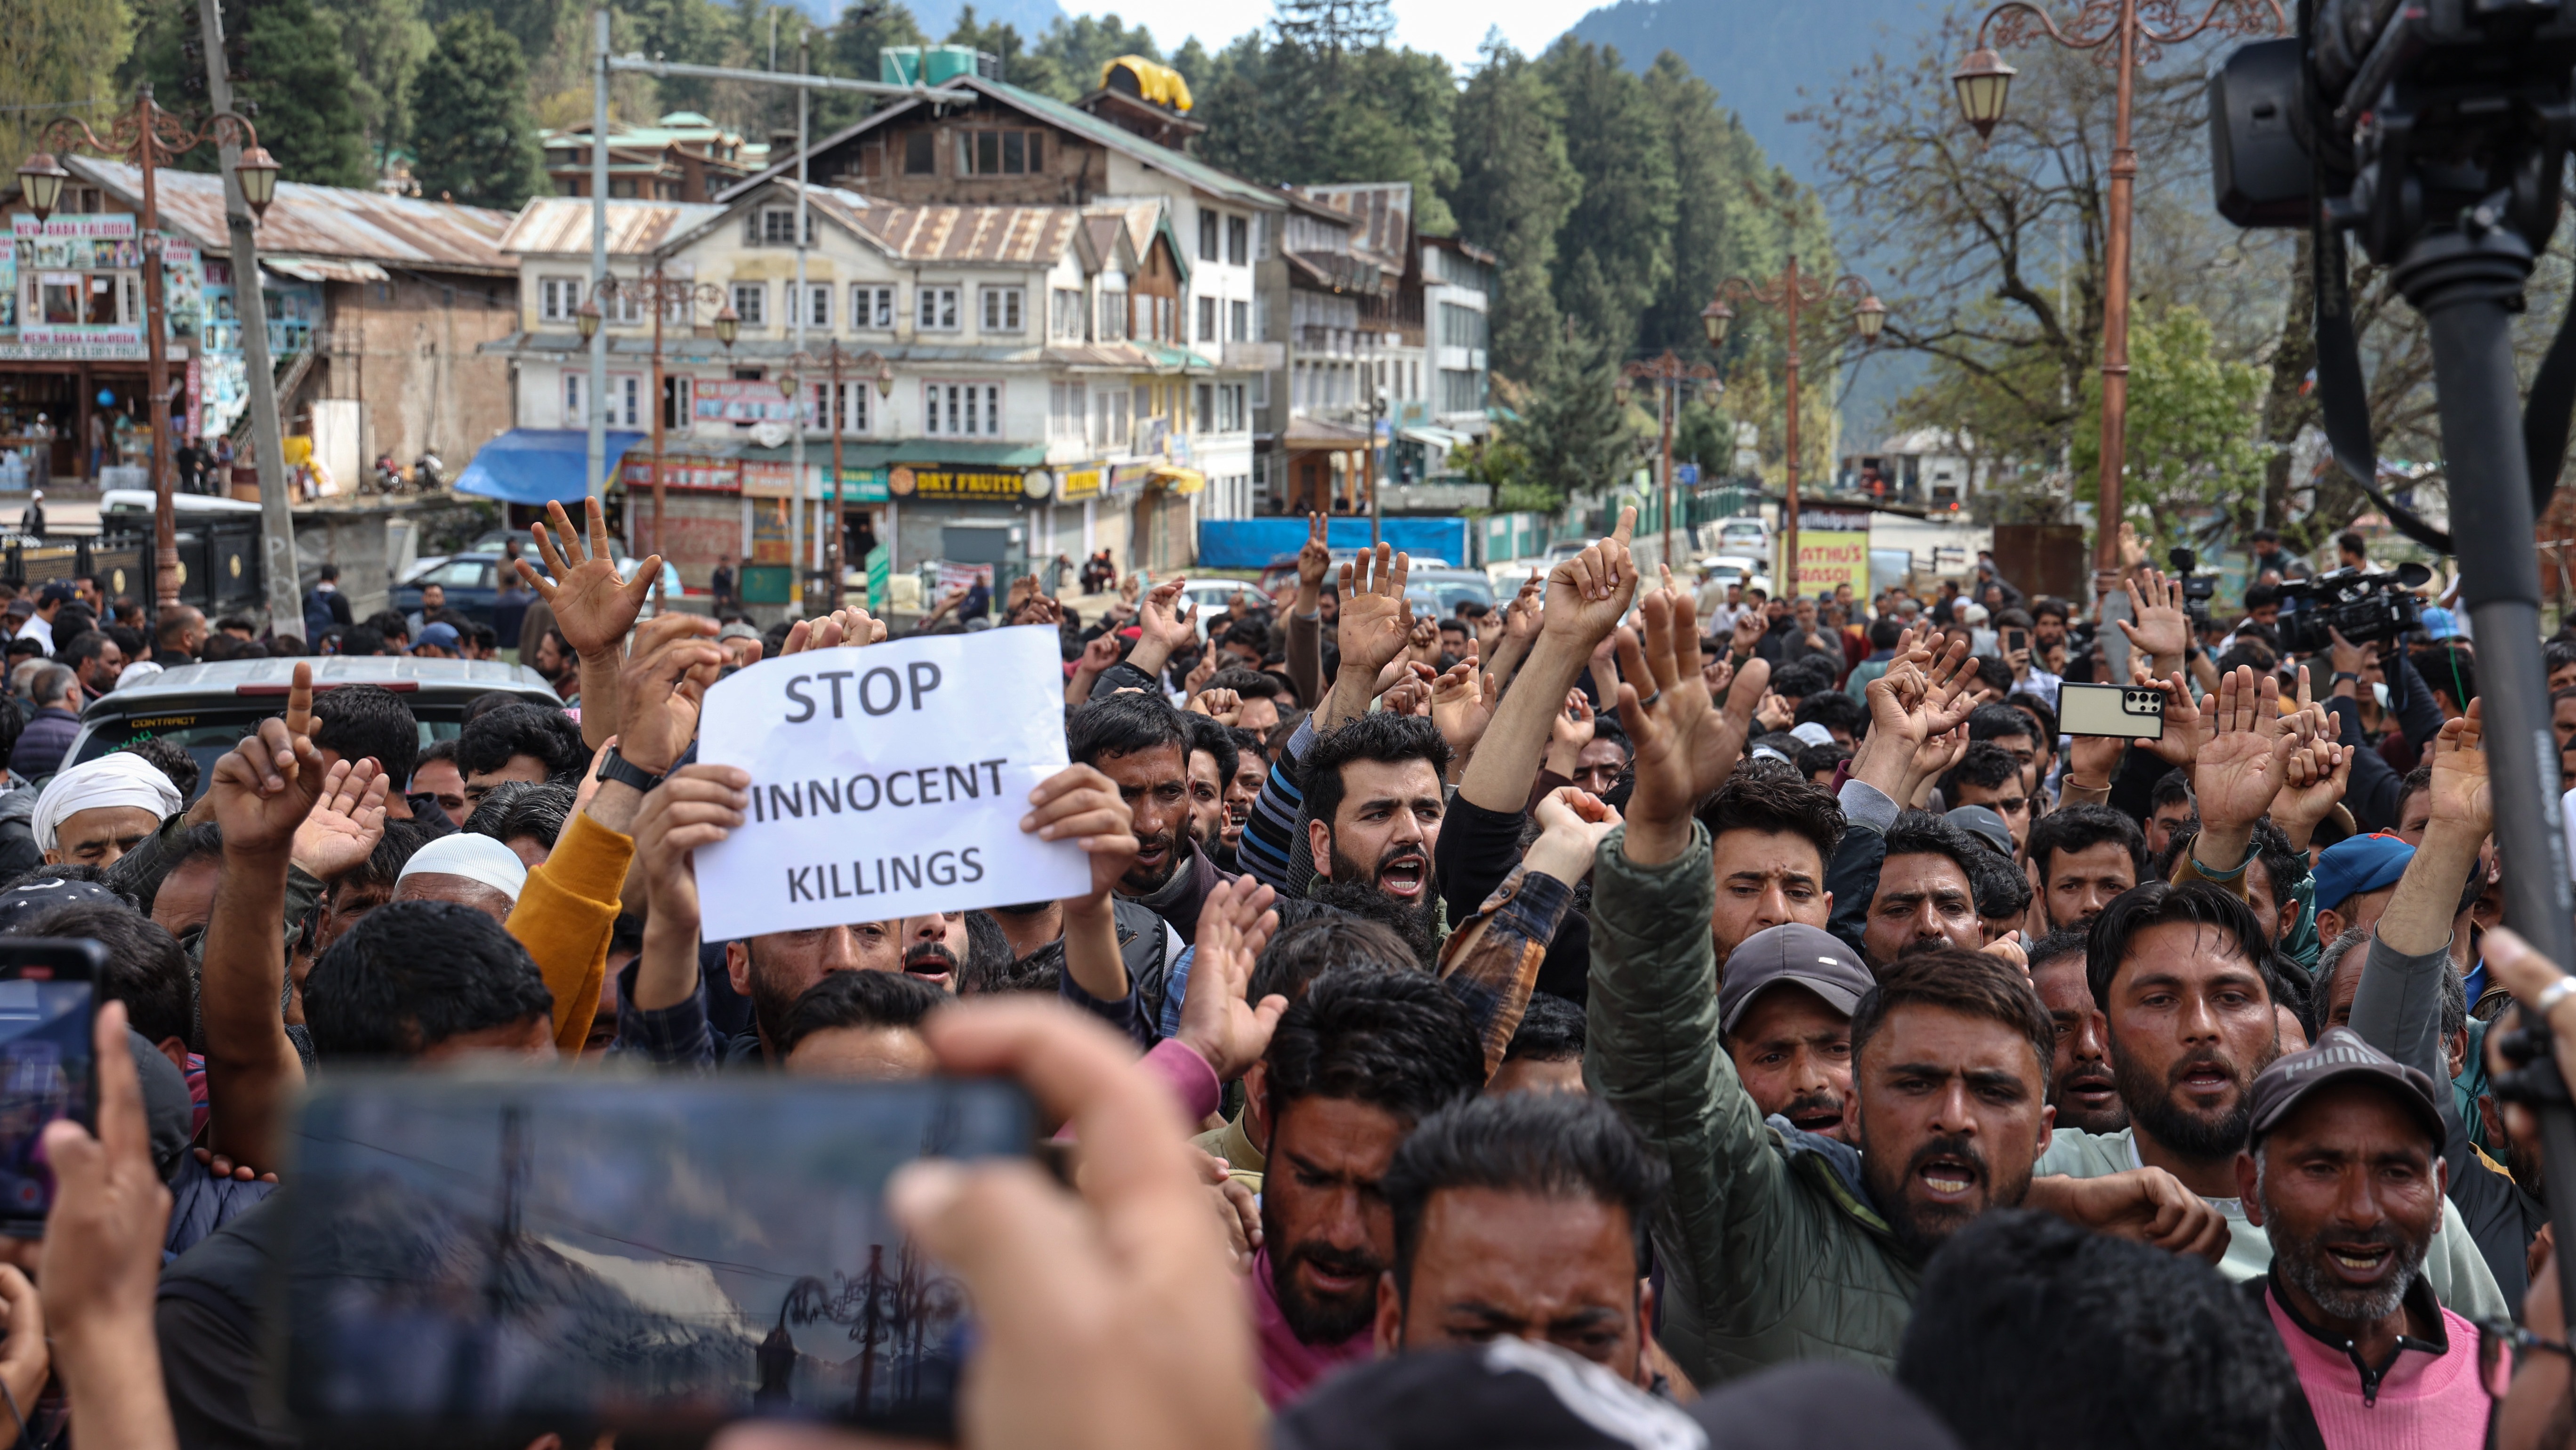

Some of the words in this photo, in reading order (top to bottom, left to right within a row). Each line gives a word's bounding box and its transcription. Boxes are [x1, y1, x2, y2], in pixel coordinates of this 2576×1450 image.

[917, 472, 952, 491] DRY
[957, 472, 1023, 493] FRUITS
[1799, 542, 1862, 563] ATHU'S
[785, 661, 942, 723] STOP
[131, 716, 196, 728] CONTRACT
[754, 758, 1007, 823] INNOCENT
[788, 848, 984, 902] KILLINGS
[2286, 1047, 2381, 1081] PUMA
